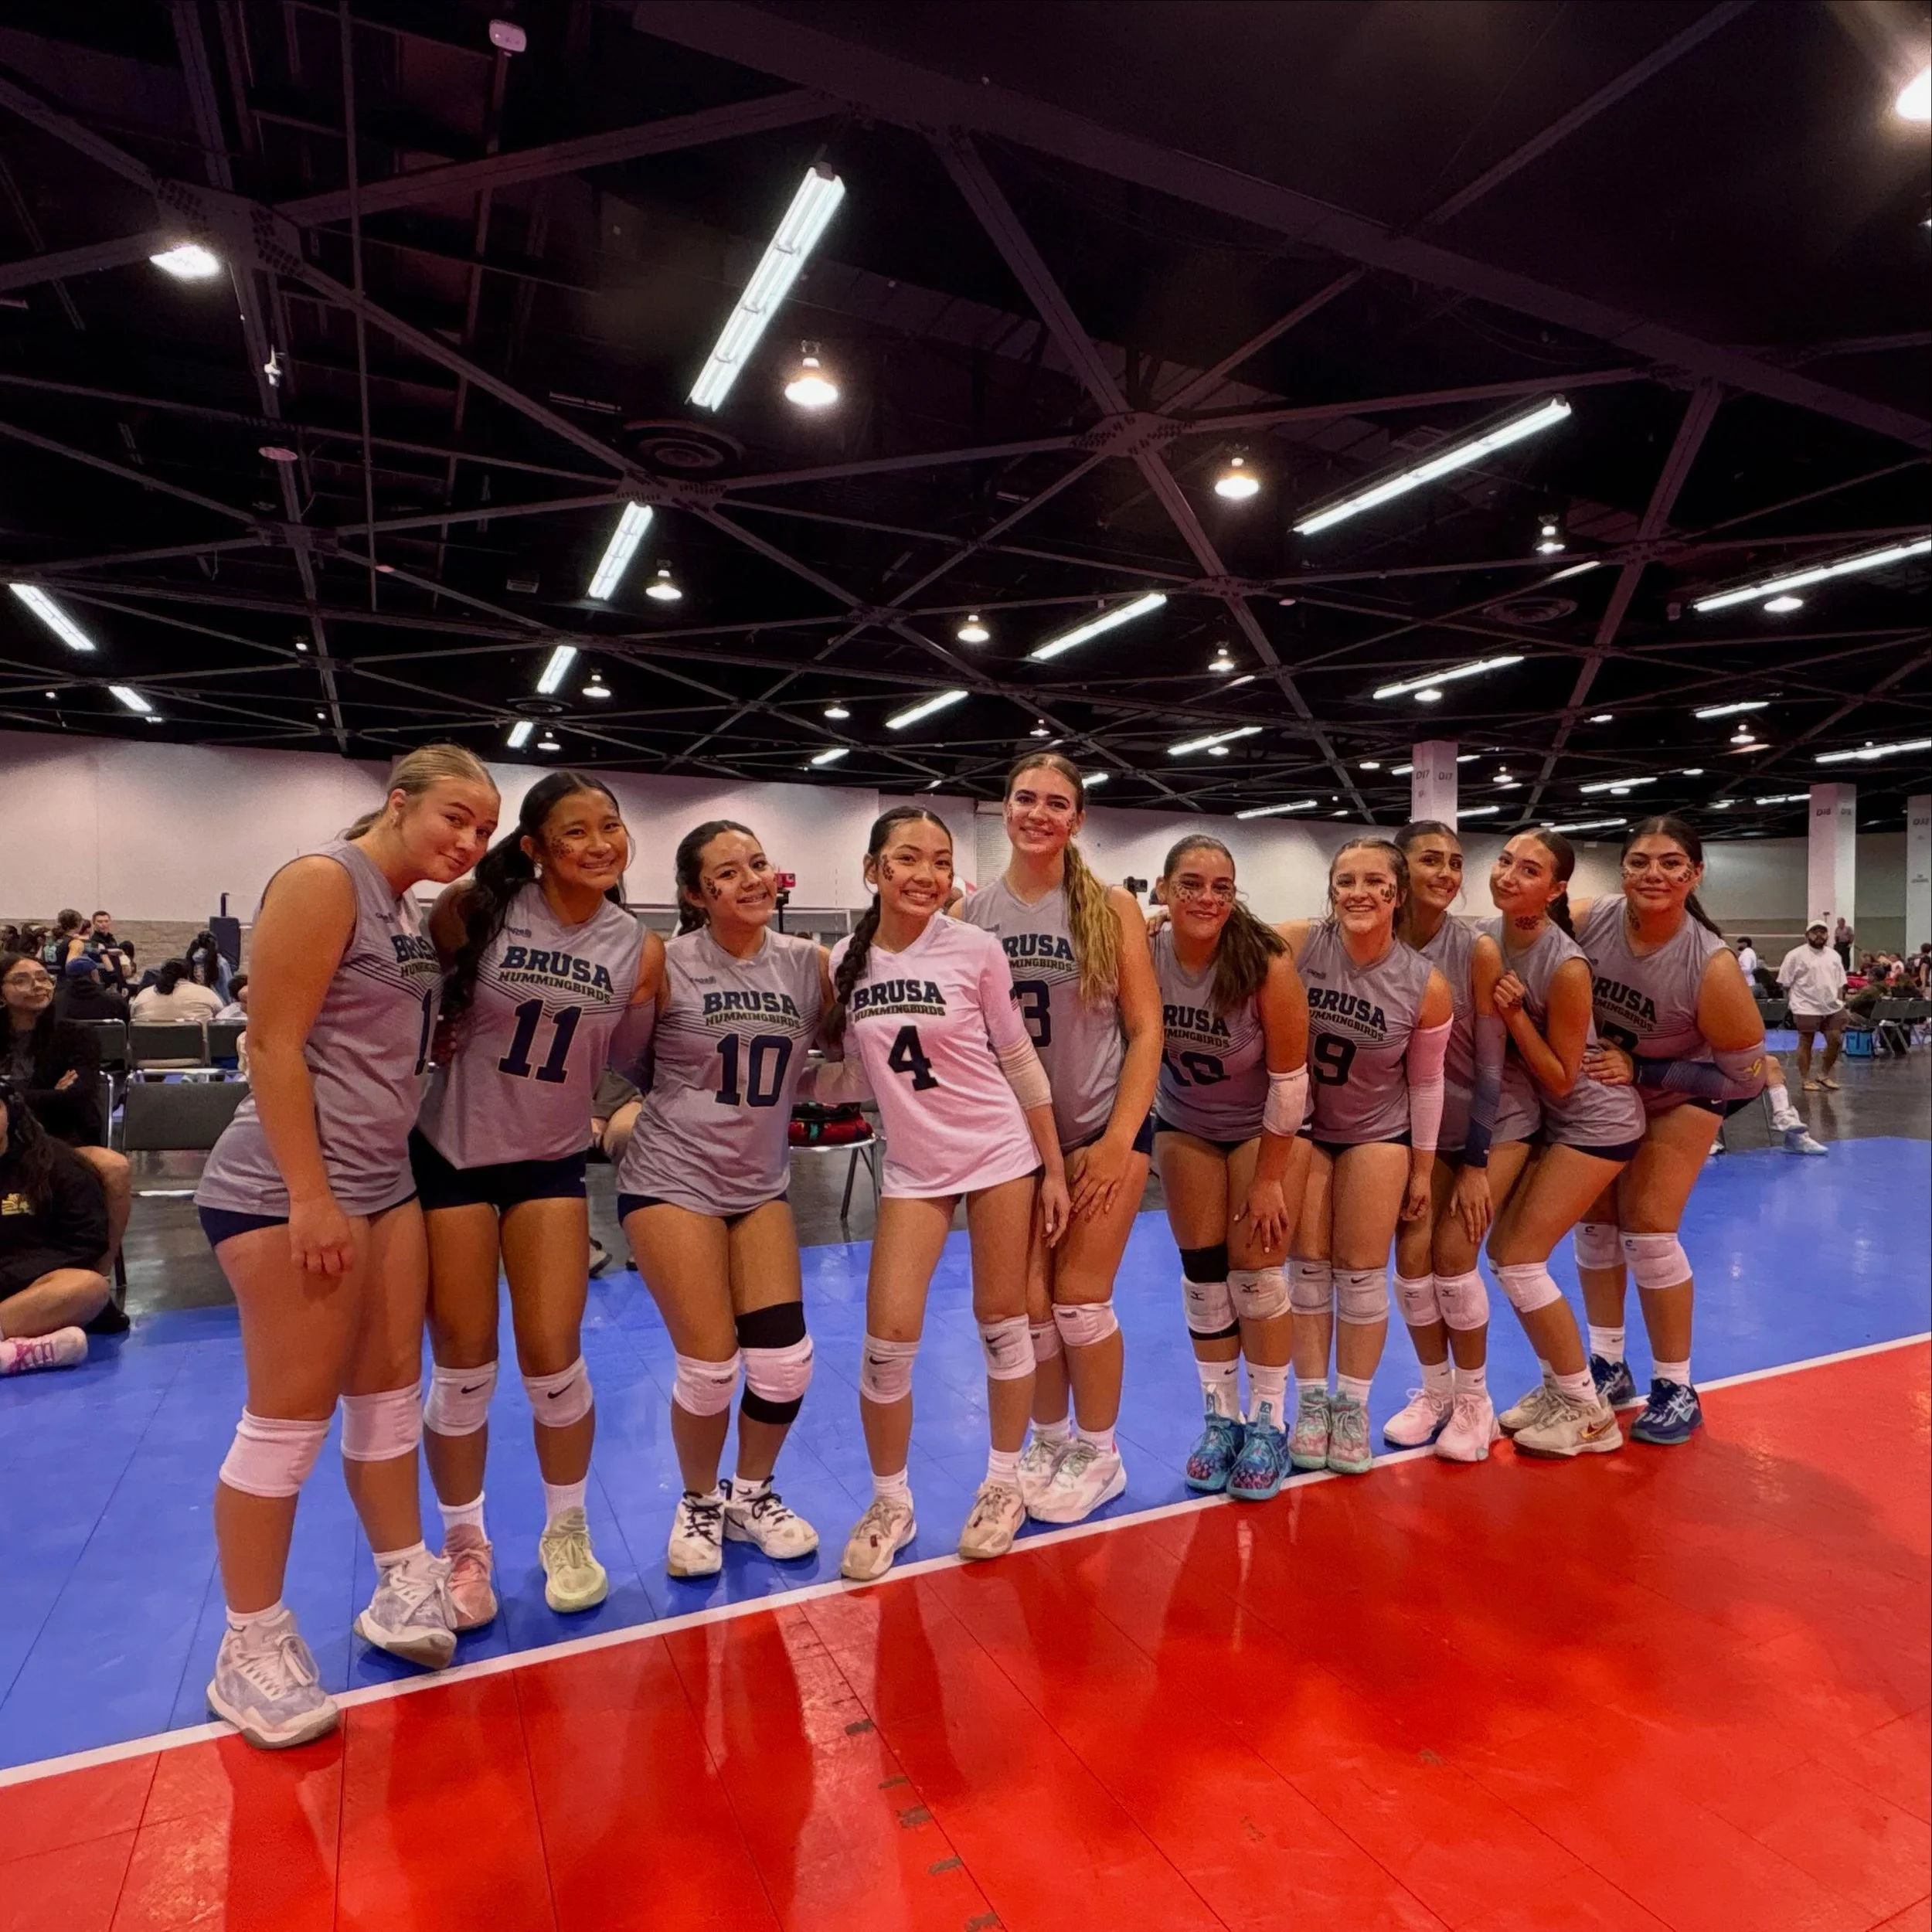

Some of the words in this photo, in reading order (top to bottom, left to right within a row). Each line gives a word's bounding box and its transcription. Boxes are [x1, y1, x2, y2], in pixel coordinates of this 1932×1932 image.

[1002, 934, 1074, 961] RUSA
[499, 946, 614, 994] BRUSA
[1009, 958, 1072, 971] MINGBIRDS
[498, 971, 611, 1004] HUMMINGBIRDS
[852, 979, 946, 1012] BRUSA
[1592, 975, 1657, 1024] RUSA
[702, 991, 801, 1019] BRUSA
[706, 1012, 800, 1029] HUMMINGBIRDS
[854, 1004, 946, 1023] HUMMINGBIRDS
[1163, 1005, 1231, 1037] RUSA
[1308, 988, 1387, 1032] BRUSA
[498, 998, 582, 1083] 11
[715, 1033, 793, 1107] 10
[888, 1026, 939, 1091] 4
[1314, 1032, 1357, 1087] 9
